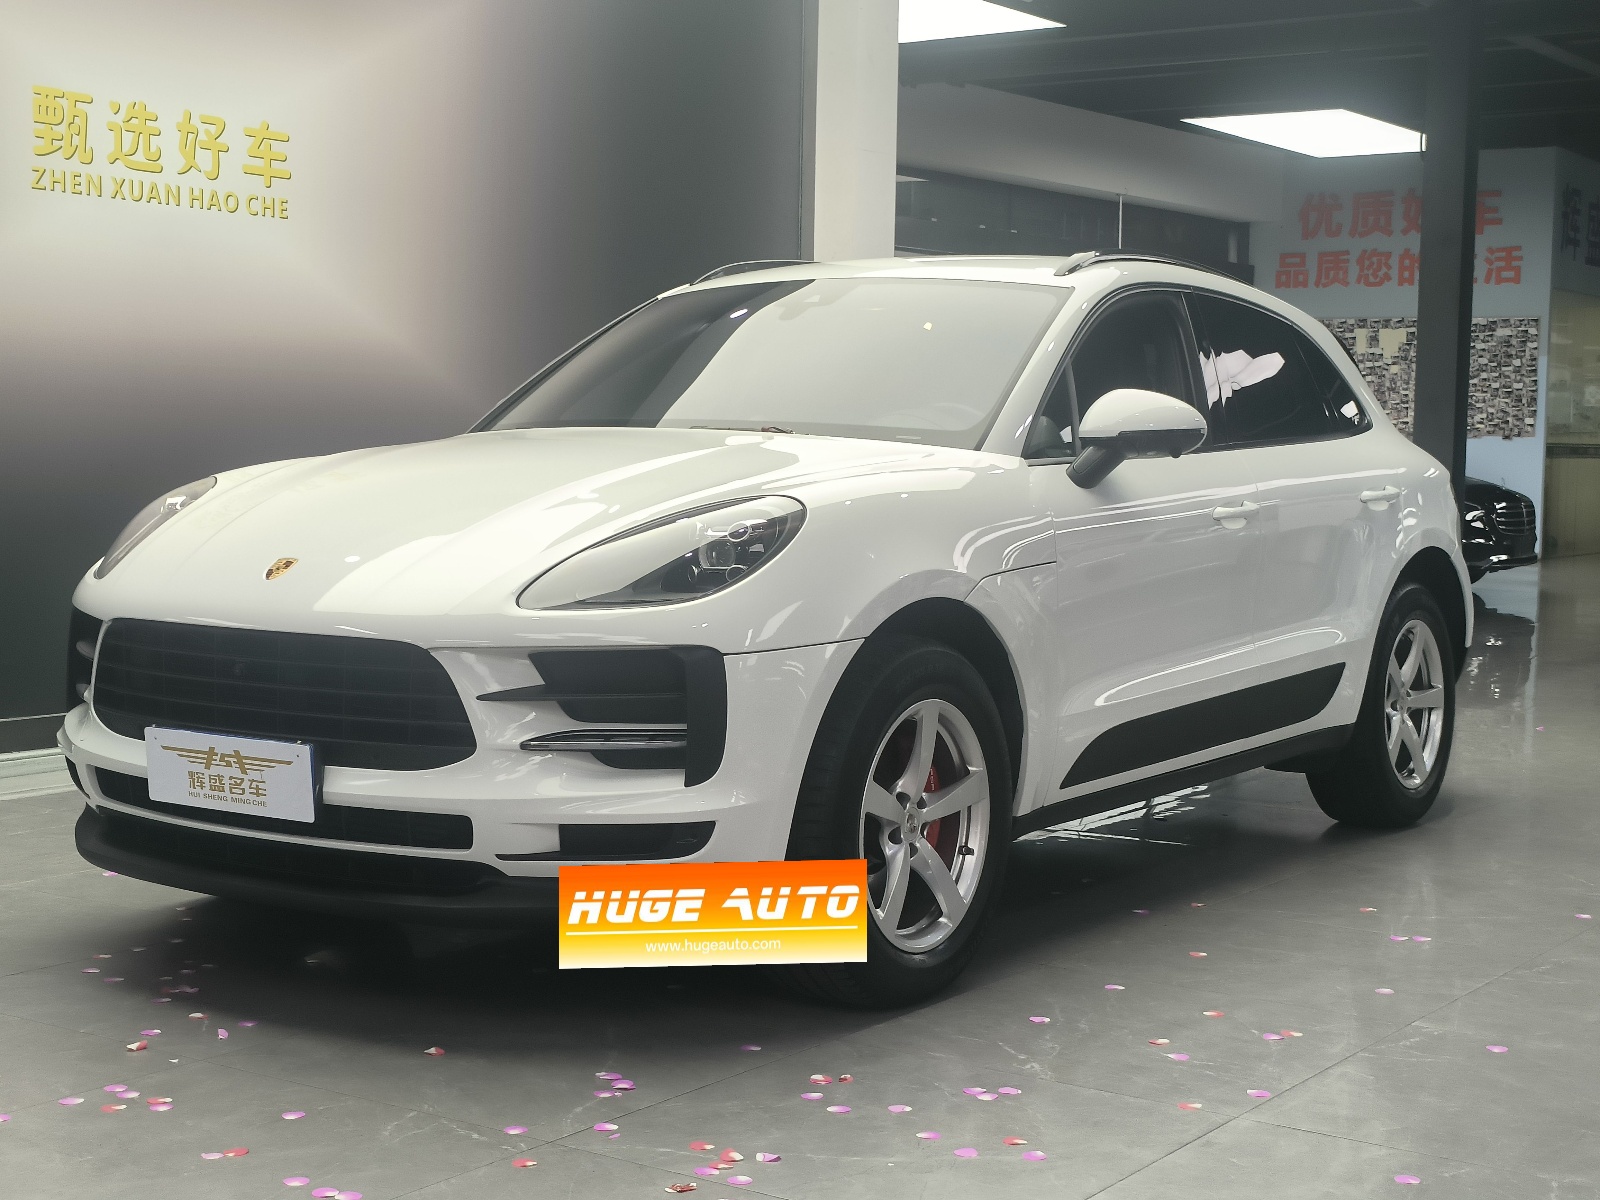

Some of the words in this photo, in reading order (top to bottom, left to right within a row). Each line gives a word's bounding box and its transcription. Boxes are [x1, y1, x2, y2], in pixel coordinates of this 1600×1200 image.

[31, 84, 292, 188] 甄选好车
[31, 165, 102, 198] ZHEN
[110, 175, 181, 207] XUAN
[188, 186, 240, 213] HAO
[245, 194, 289, 220] CHE
[1274, 245, 1524, 290] 品质您的活
[188, 770, 267, 798] 辉盛名车
[203, 793, 228, 802] SHENG
[230, 796, 251, 805] MING
[252, 799, 268, 808] CHE
